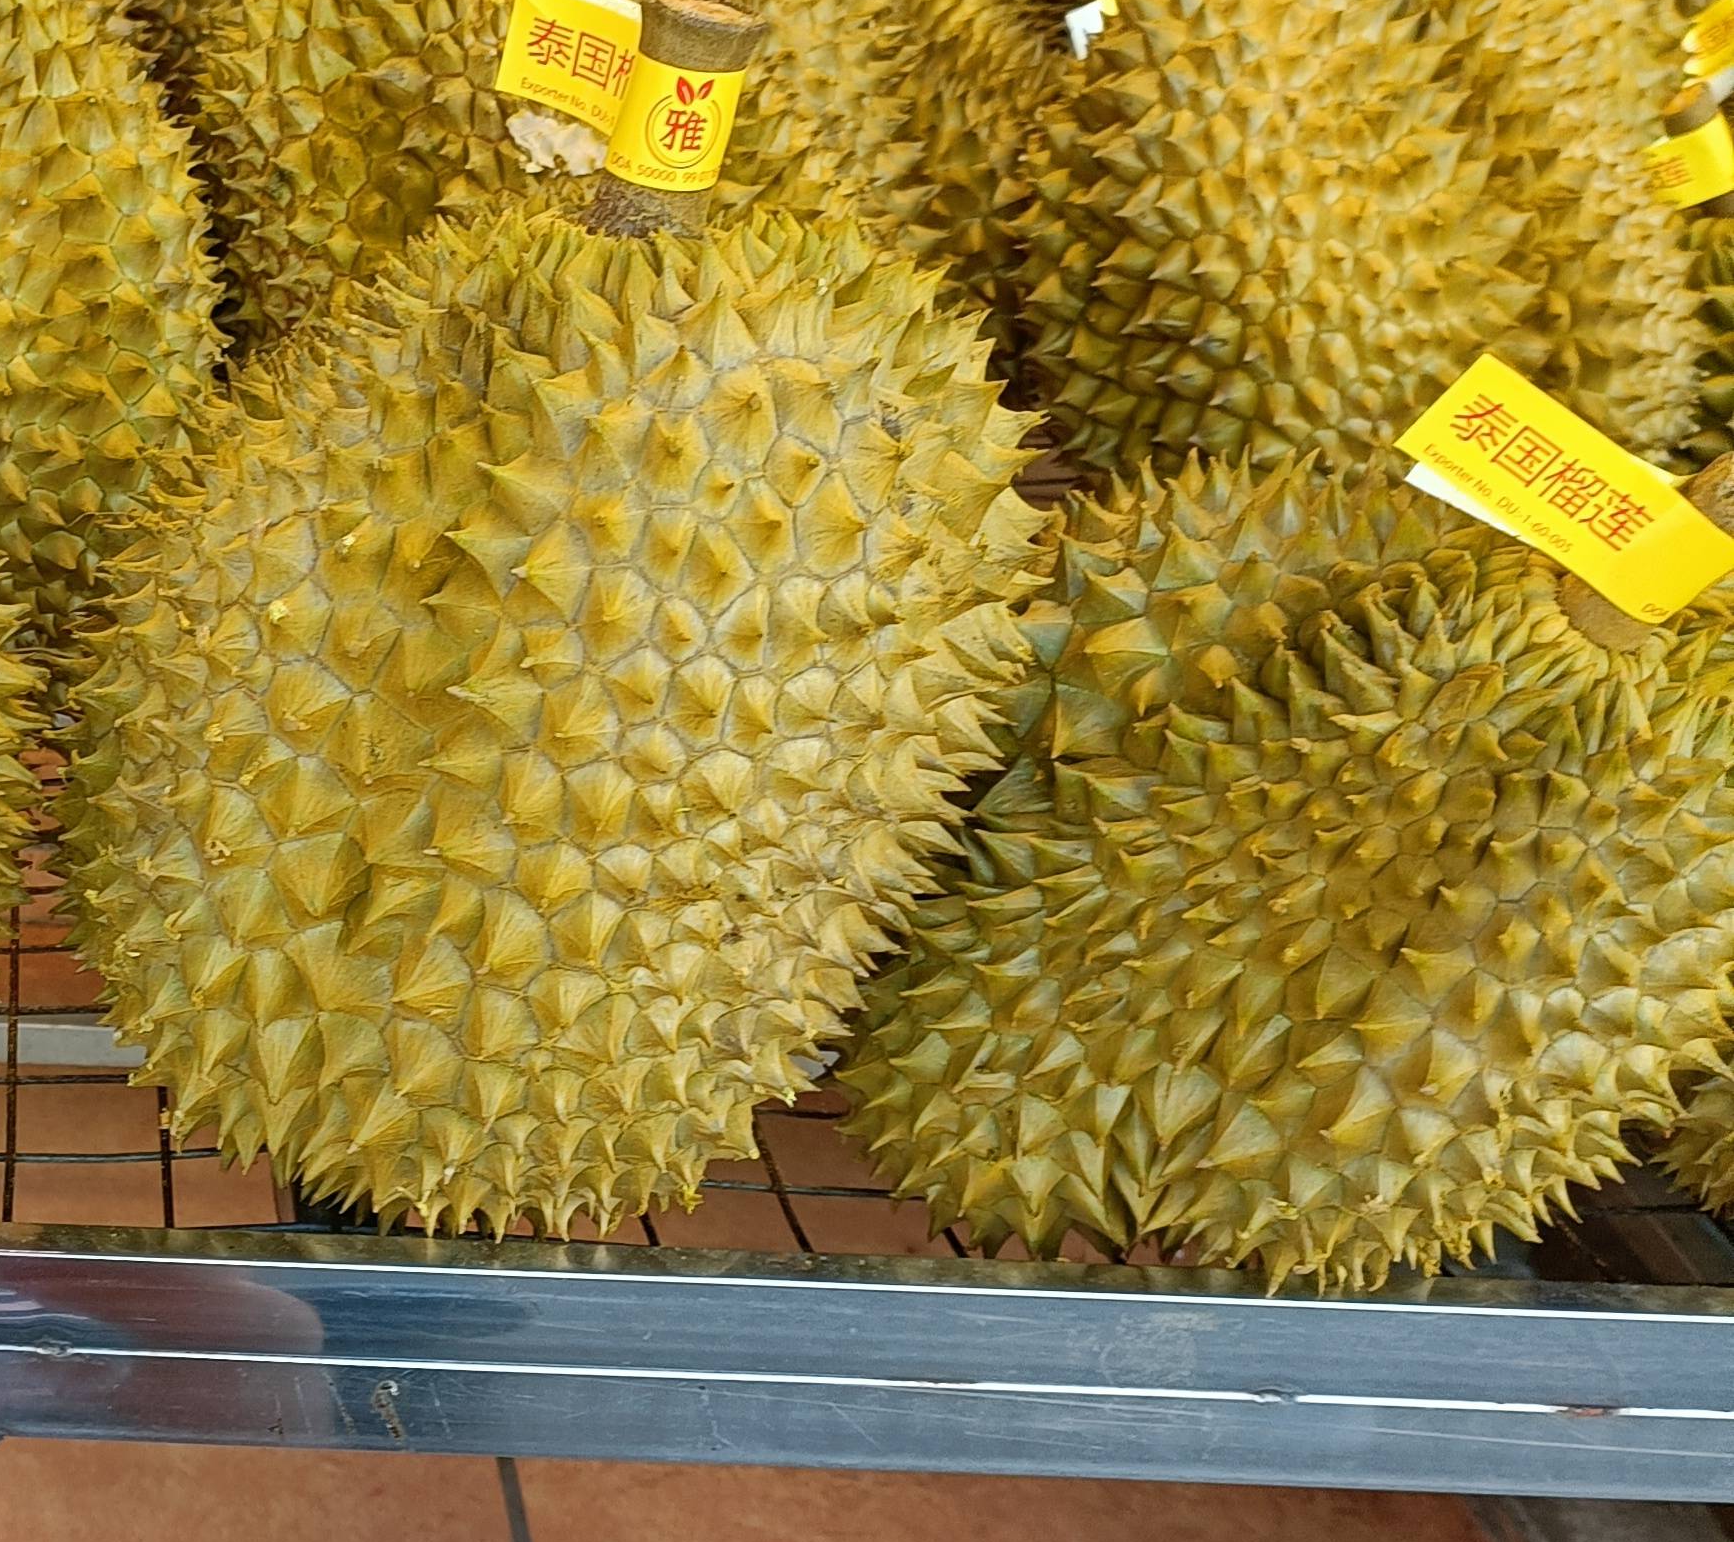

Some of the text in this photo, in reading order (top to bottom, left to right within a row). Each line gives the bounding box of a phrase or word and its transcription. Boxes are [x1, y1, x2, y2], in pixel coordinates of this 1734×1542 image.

[659, 109, 708, 152] 雅
[1449, 393, 1655, 552] 泰国榴莲
